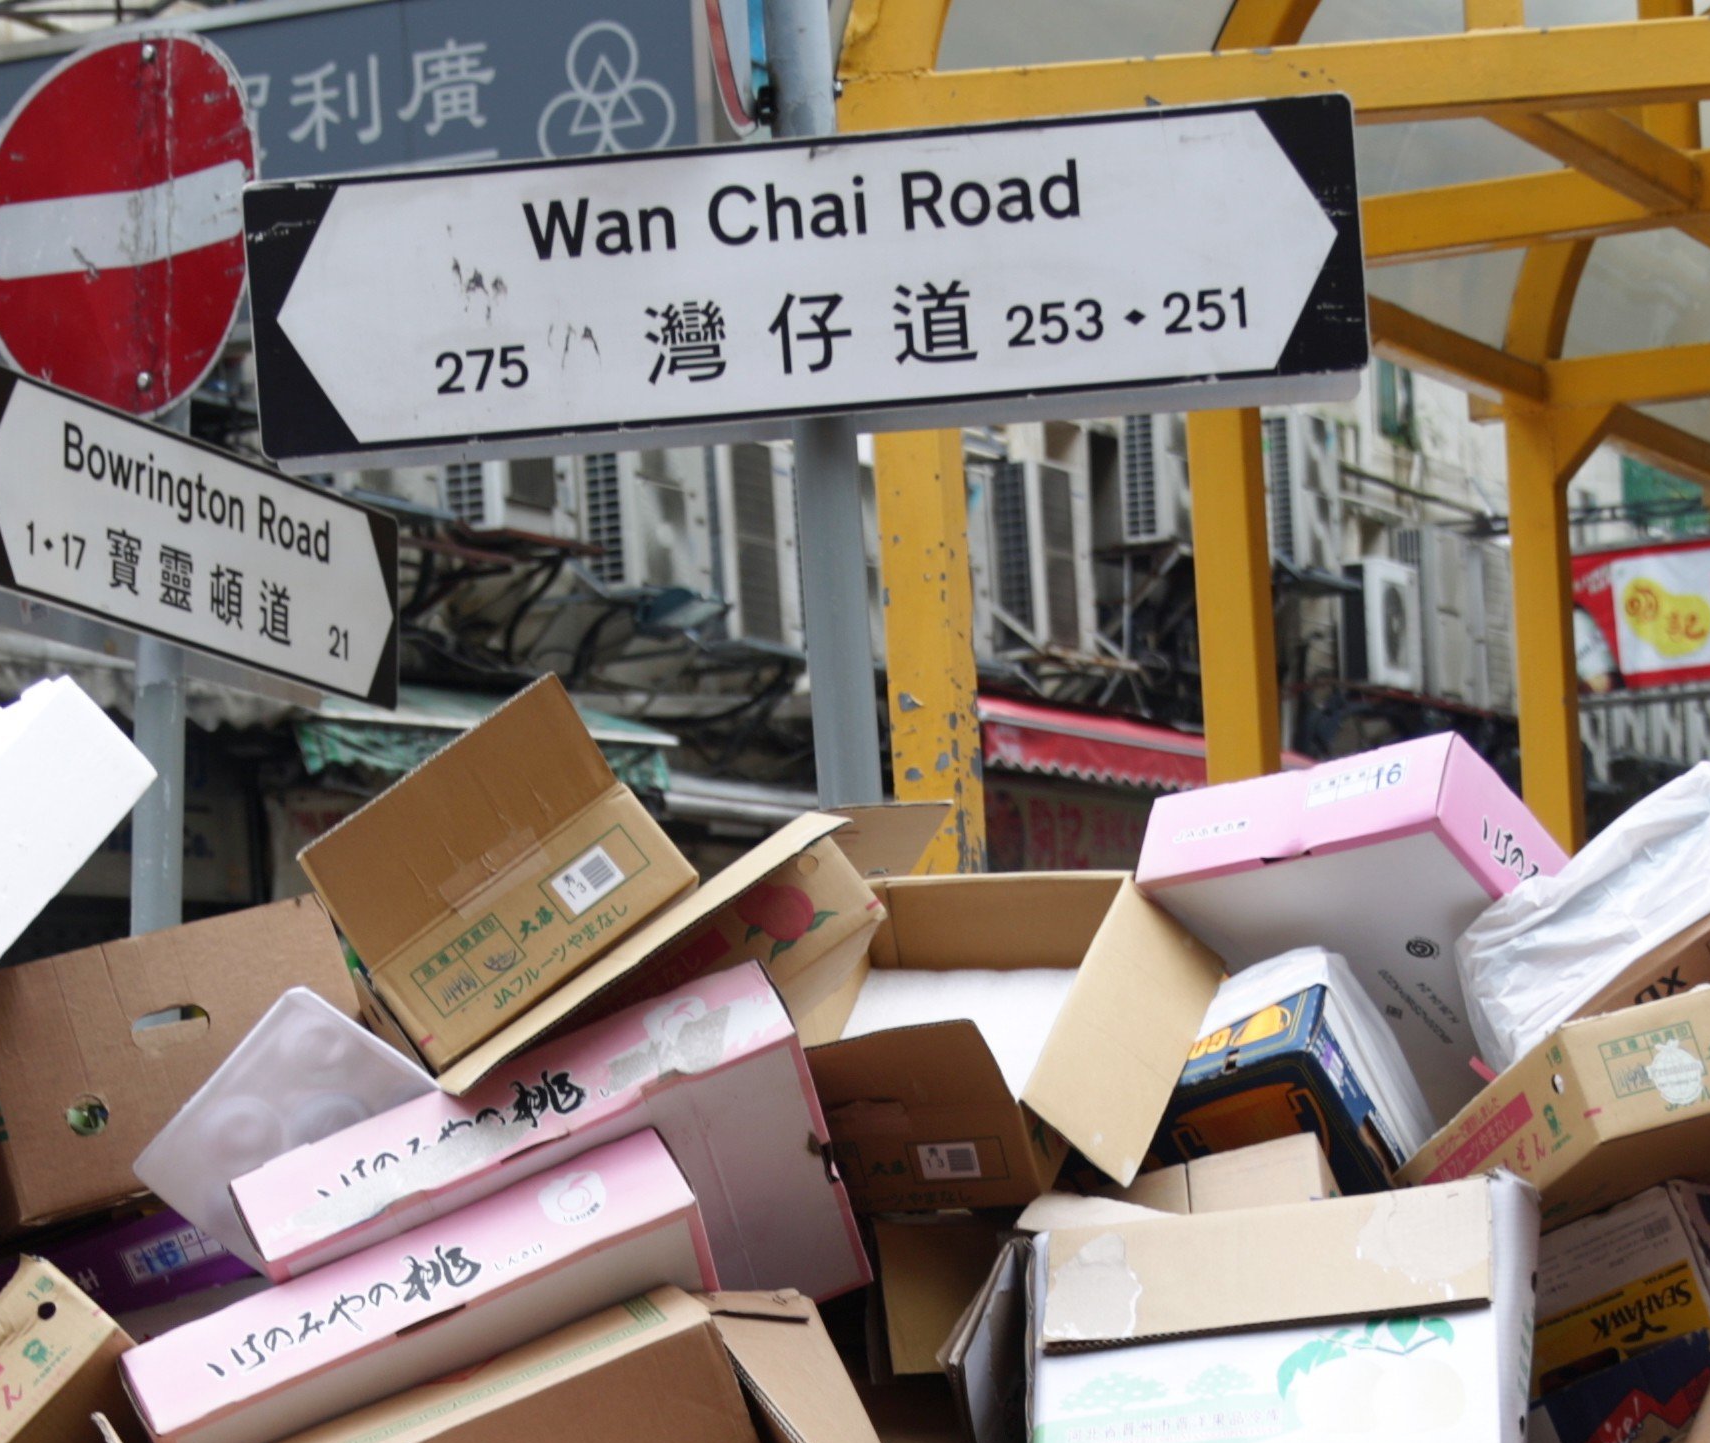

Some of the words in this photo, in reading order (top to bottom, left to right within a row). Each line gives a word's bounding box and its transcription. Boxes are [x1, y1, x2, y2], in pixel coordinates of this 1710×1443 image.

[524, 197, 678, 260] Wan
[707, 175, 868, 245] Chai
[901, 159, 1082, 230] Road
[434, 344, 530, 395] 275
[643, 280, 979, 384] 灣仔道
[1005, 300, 1104, 347] 253
[1163, 286, 1251, 336] 251
[61, 422, 245, 534] Bowrington
[256, 499, 331, 564] Road
[104, 528, 292, 645] 寶靈頓道
[327, 624, 351, 661] 21
[492, 902, 629, 1011] JAフルーツやまなし
[1591, 1278, 1693, 1343] SEAHAWK
